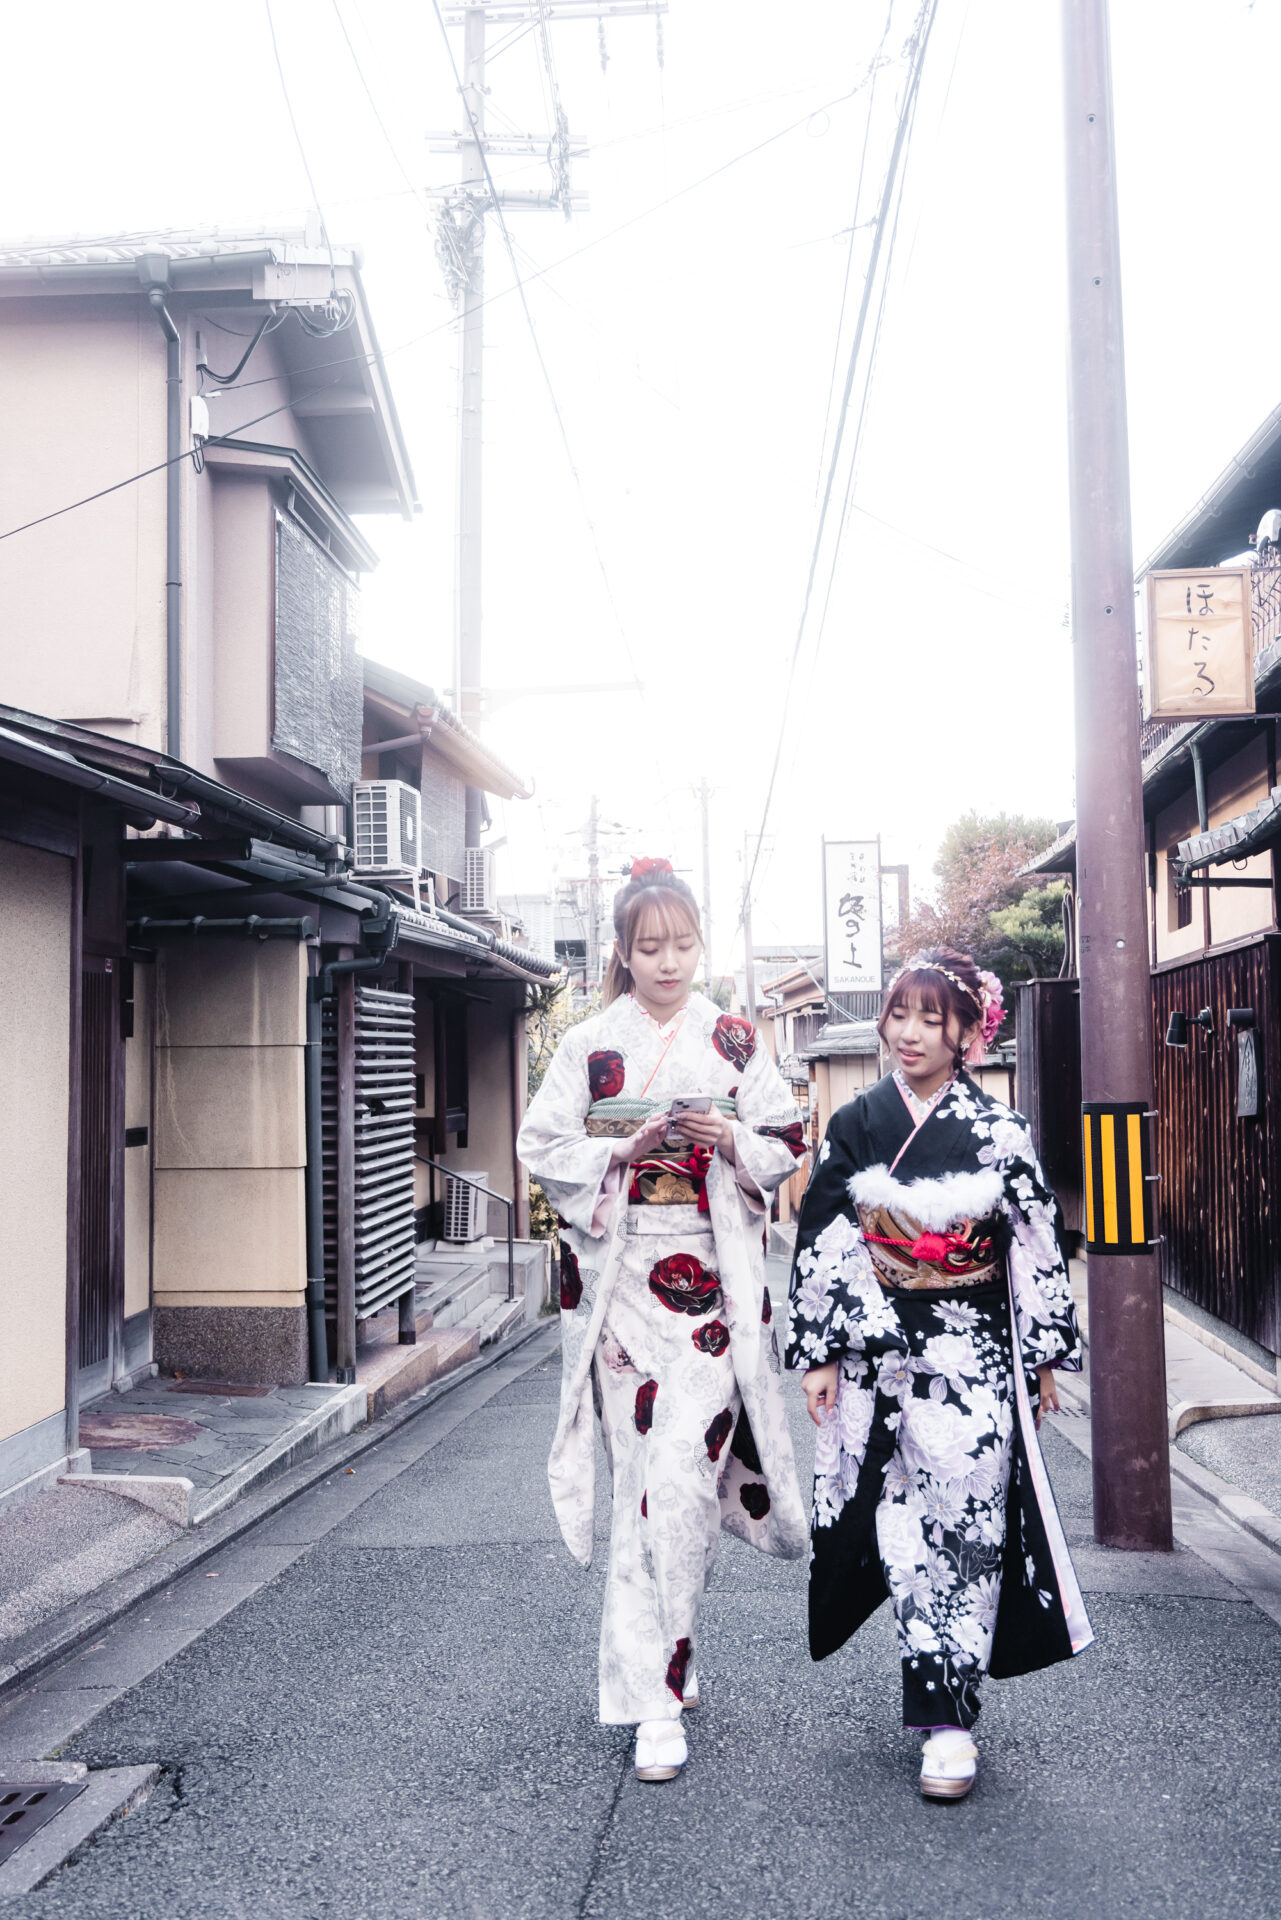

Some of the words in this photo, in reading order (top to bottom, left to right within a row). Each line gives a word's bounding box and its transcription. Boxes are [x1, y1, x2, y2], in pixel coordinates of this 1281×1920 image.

[1186, 584, 1215, 696] ほたる
[838, 893, 865, 969] 坂の上
[833, 975, 876, 984] SAKANOUE
